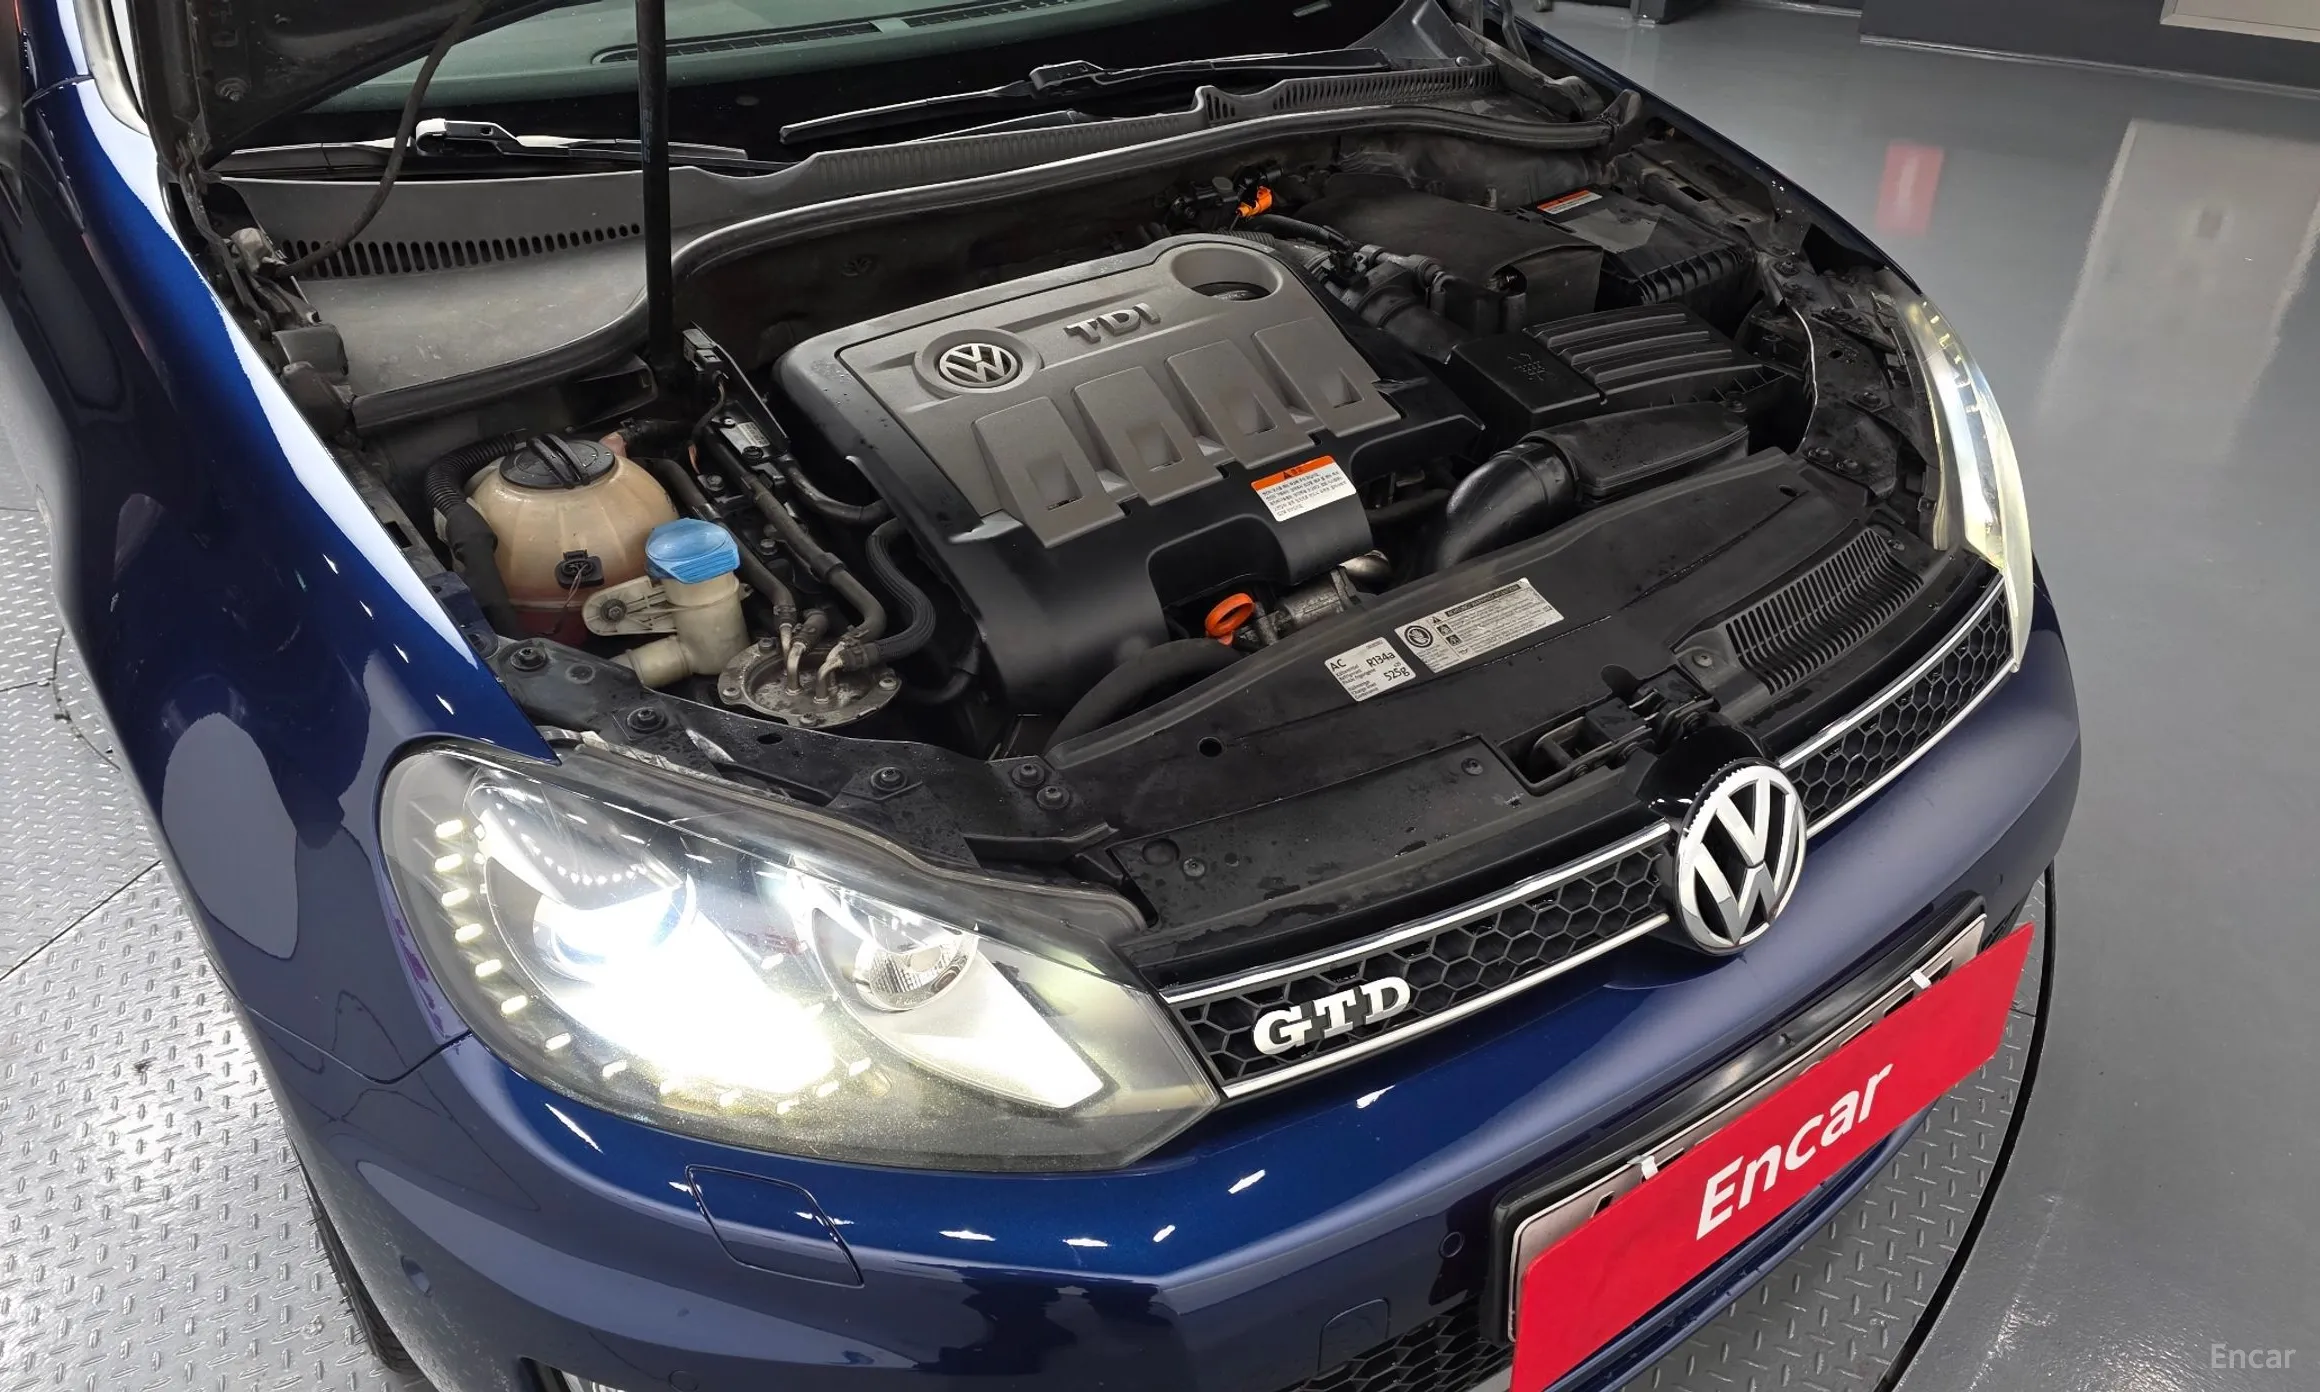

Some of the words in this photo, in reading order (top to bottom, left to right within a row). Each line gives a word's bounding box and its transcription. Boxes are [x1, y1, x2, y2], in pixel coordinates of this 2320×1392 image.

[1063, 302, 1161, 344] TDI
[939, 343, 1018, 388] VW
[1330, 659, 1346, 672] AC
[1366, 652, 1396, 667] R134a
[1383, 667, 1411, 681] 525g
[1680, 766, 1806, 948] VW
[1254, 976, 1410, 1054] GTD
[1696, 1063, 1893, 1240] Encar
